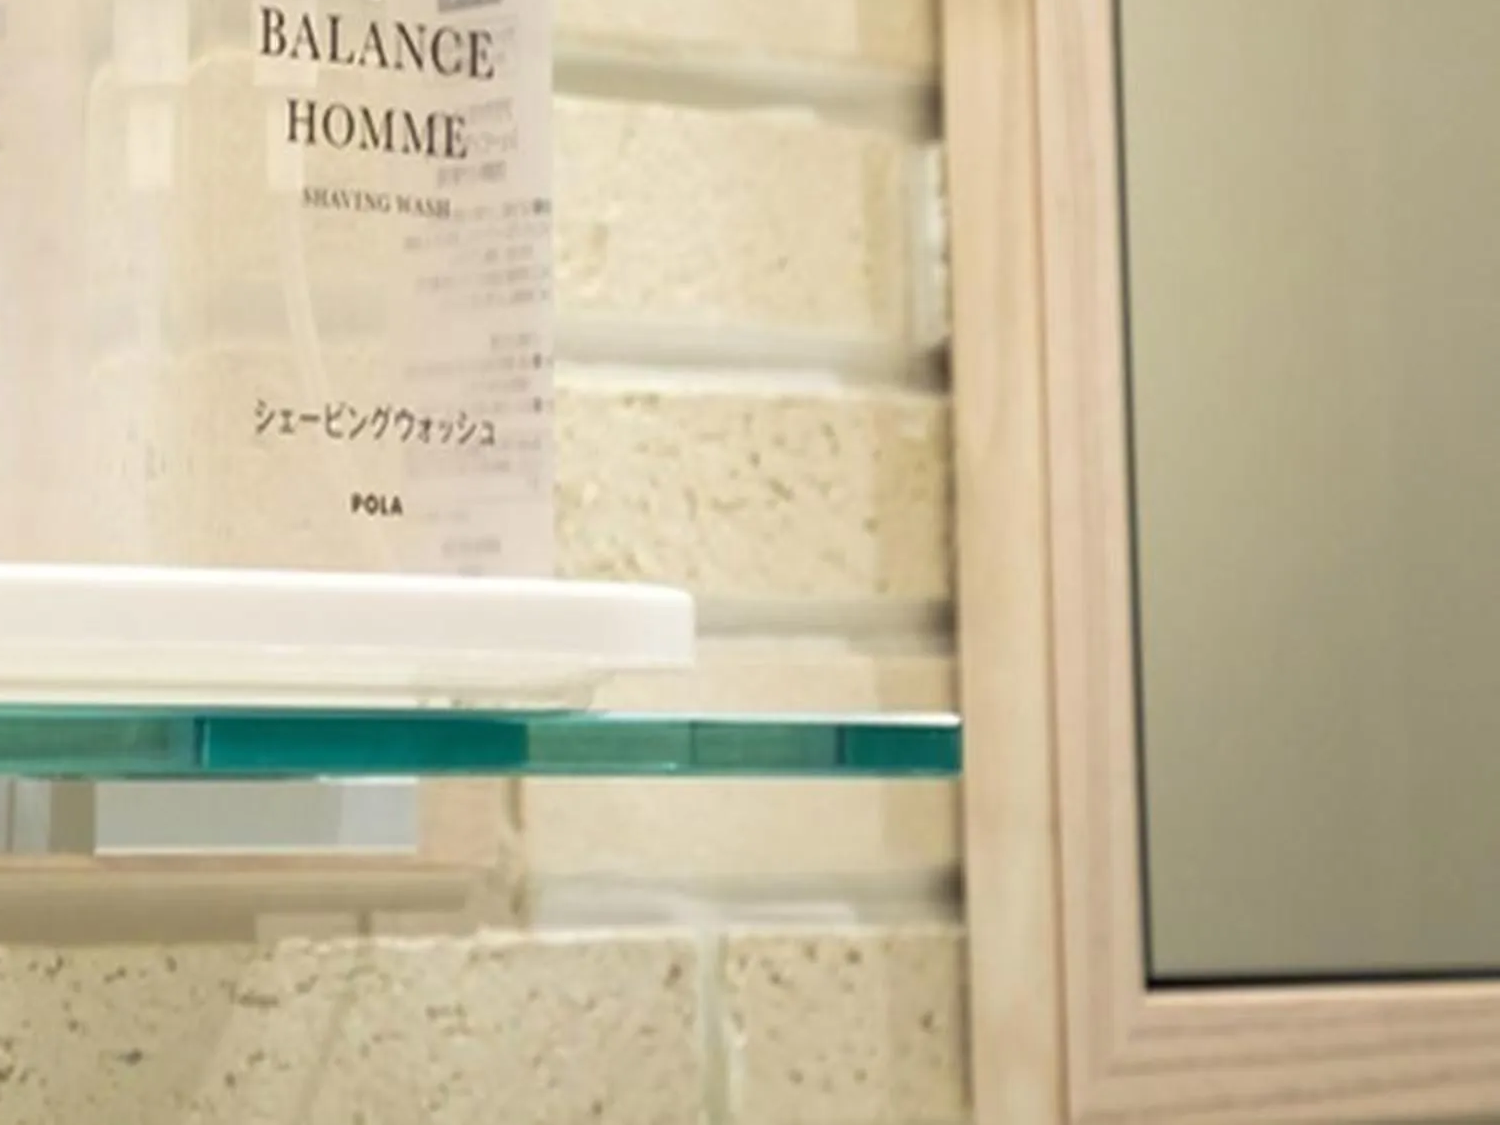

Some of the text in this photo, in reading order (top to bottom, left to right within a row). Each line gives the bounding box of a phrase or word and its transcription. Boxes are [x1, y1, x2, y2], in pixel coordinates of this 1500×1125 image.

[260, 5, 495, 81] BALANCE
[286, 98, 468, 160] HOMME
[303, 186, 392, 215] SHAVING
[396, 192, 451, 220] WASH
[351, 492, 404, 516] POLA
